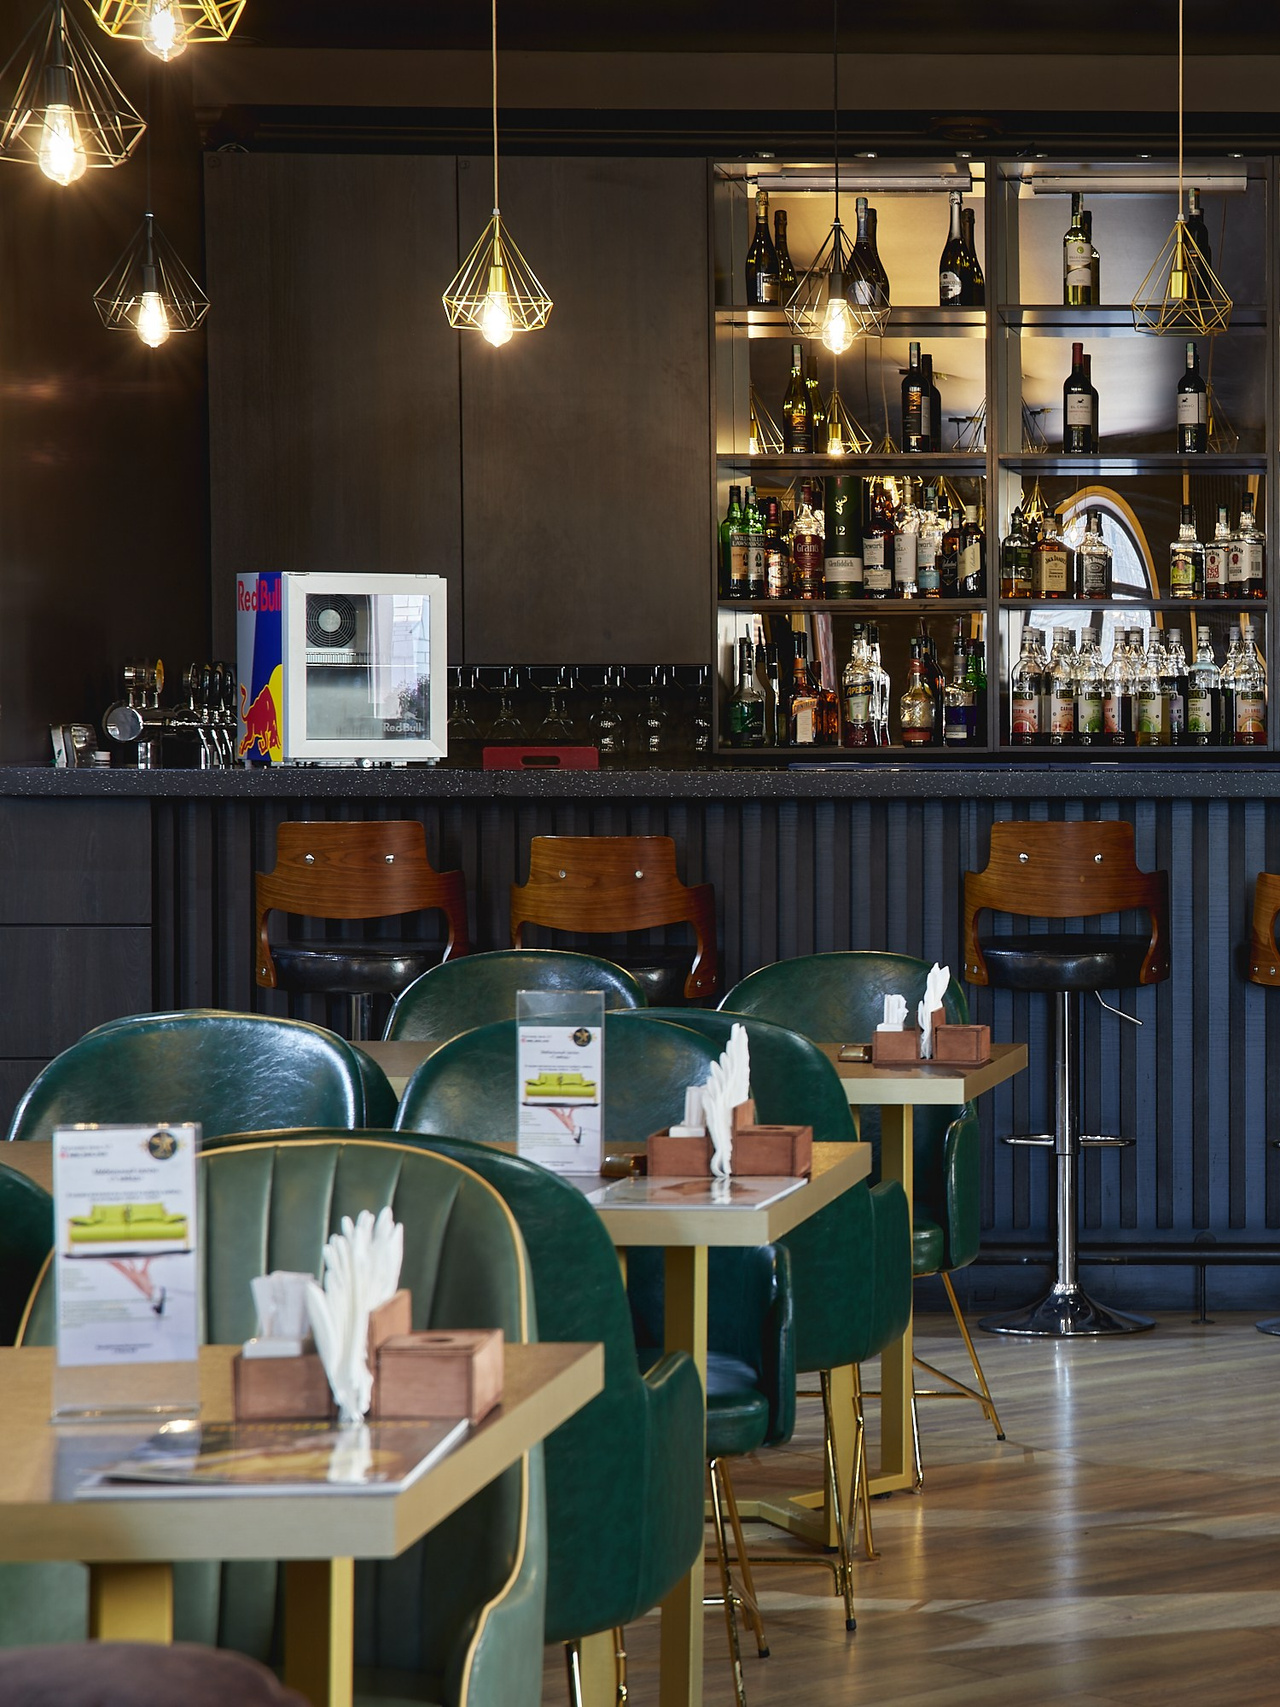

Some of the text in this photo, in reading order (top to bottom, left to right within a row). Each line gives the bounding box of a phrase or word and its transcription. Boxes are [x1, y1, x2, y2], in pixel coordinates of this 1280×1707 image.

[835, 526, 846, 535] 12
[238, 578, 281, 611] Red Bull
[846, 685, 871, 696] APEROL
[383, 722, 421, 732] Red Bull
